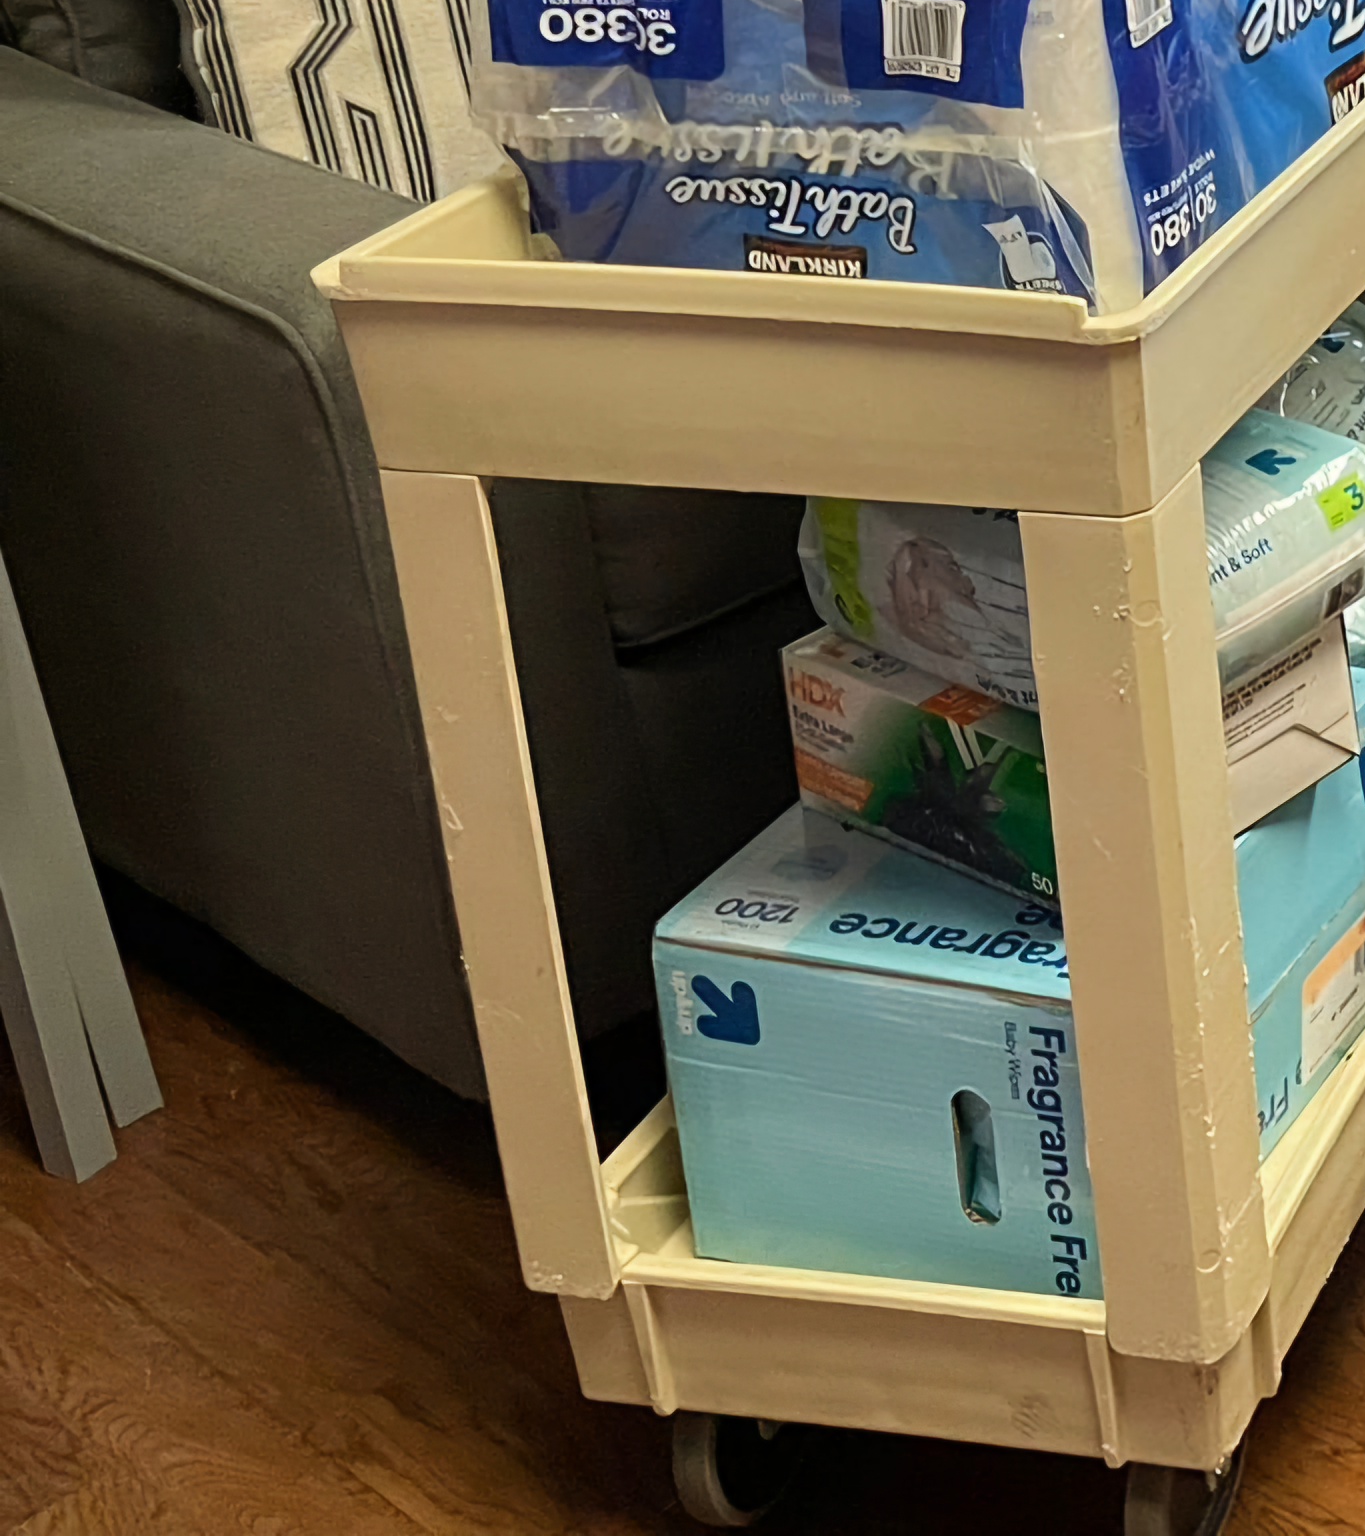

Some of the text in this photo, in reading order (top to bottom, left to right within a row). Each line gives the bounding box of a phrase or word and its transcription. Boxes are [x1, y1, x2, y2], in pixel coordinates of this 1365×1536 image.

[665, 174, 917, 254] Bath Tissue
[1196, 183, 1218, 224] 30
[1150, 210, 1191, 257] 380
[748, 250, 862, 279] KIRKLAND
[1343, 482, 1365, 512] 3
[1227, 555, 1242, 574] &
[1241, 537, 1274, 566] Soft
[1031, 871, 1053, 896] 50
[715, 898, 800, 925] 1200
[828, 910, 1070, 980] ragrance
[1026, 1025, 1088, 1294] Fragrance Fre
